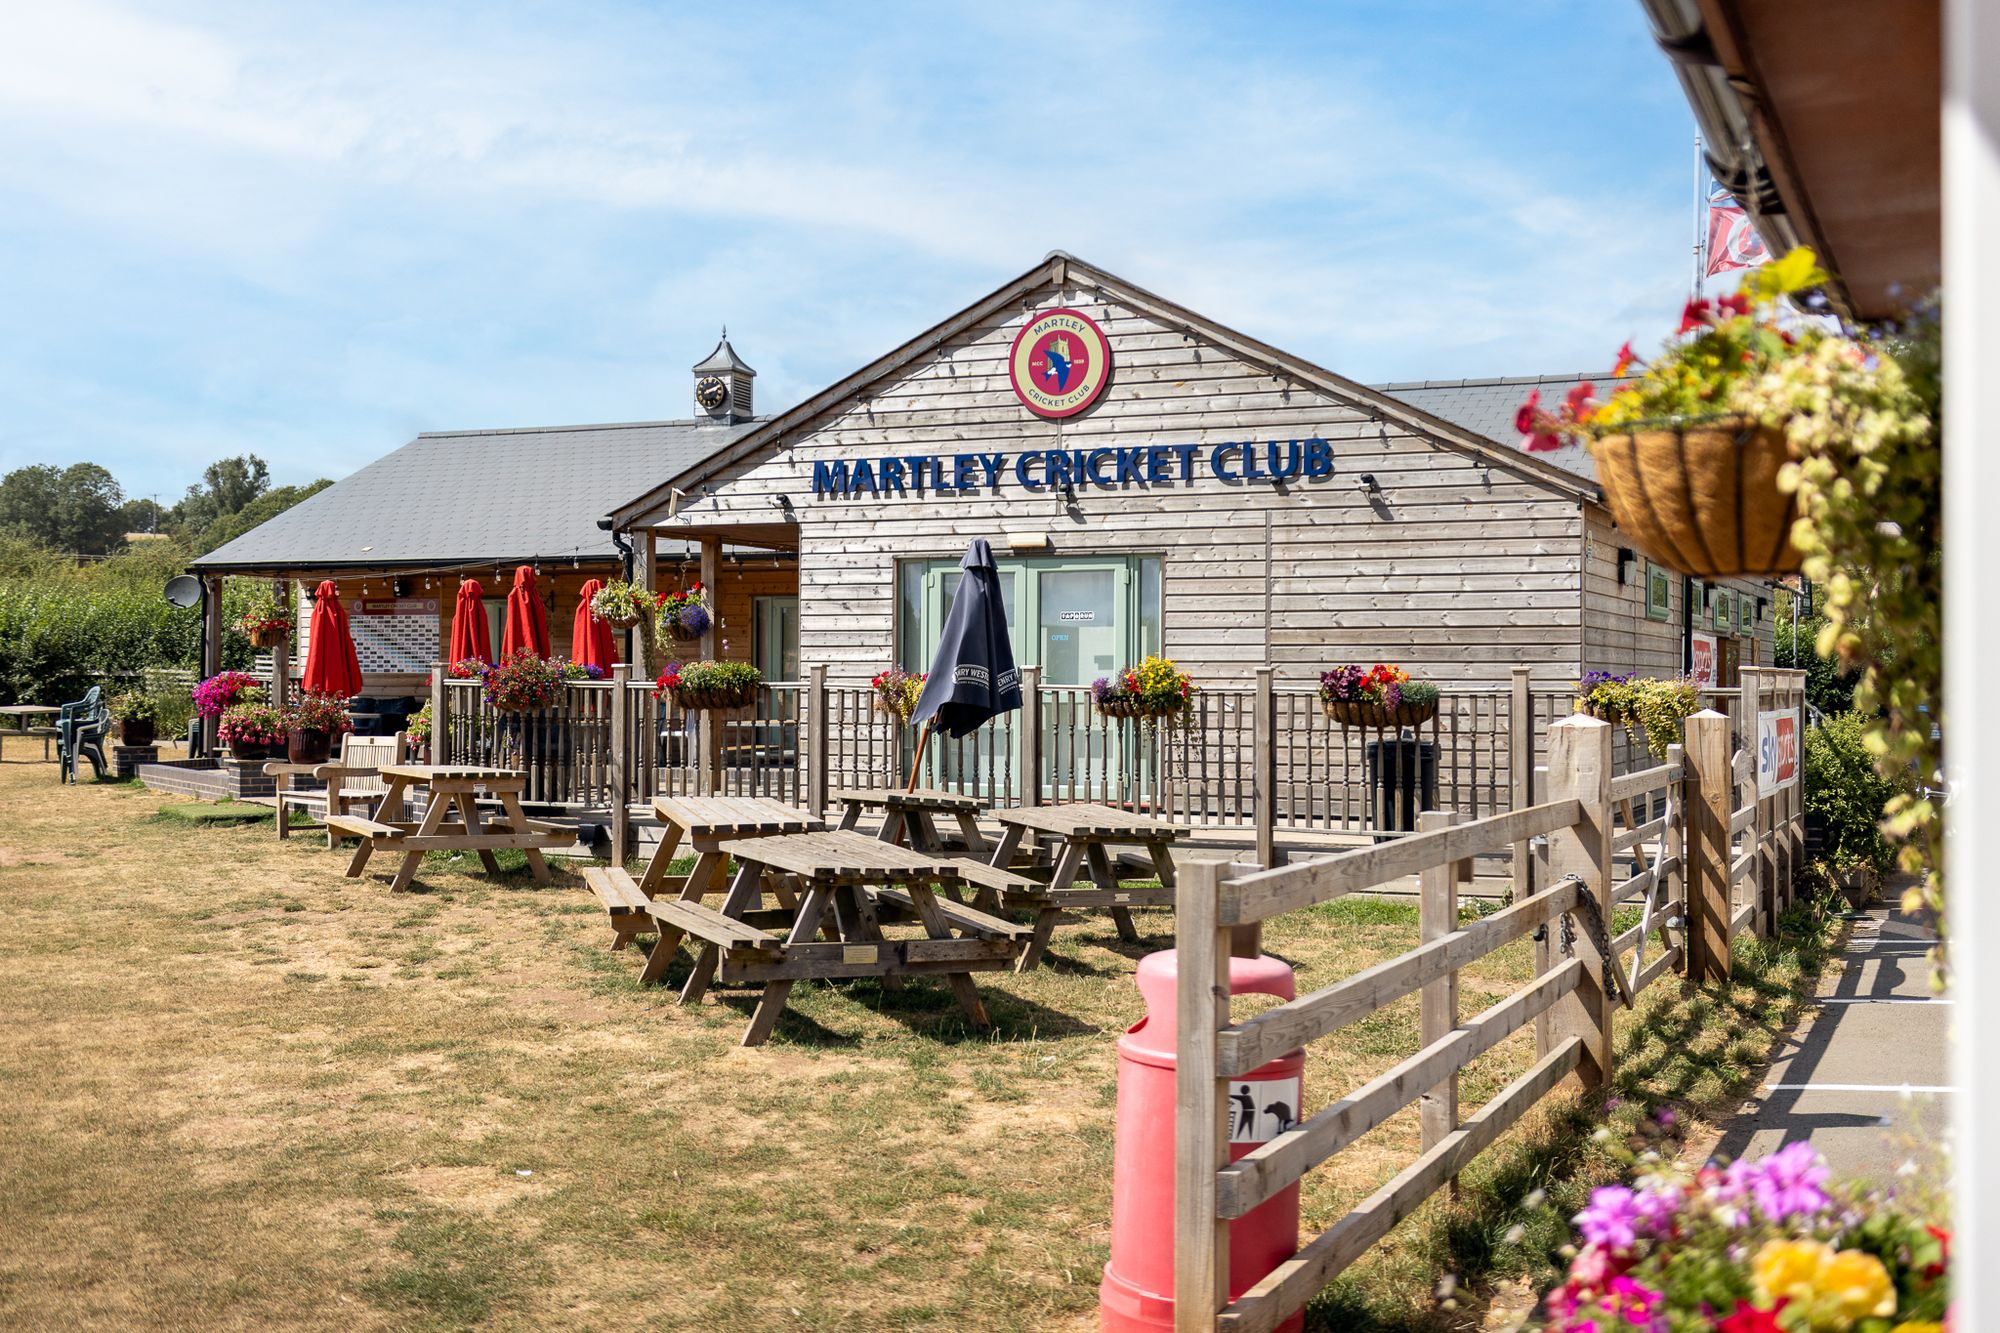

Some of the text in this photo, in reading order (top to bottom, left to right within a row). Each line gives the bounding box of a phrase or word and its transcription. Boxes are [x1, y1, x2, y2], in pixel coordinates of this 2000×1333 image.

[1034, 318, 1085, 335] MARTLEY
[1028, 384, 1090, 406] CRICKET CLUB
[812, 438, 1334, 493] MARTLEY CRICKET CLUB
[997, 673, 1013, 687] ENRY
[1762, 724, 1777, 783] sky
